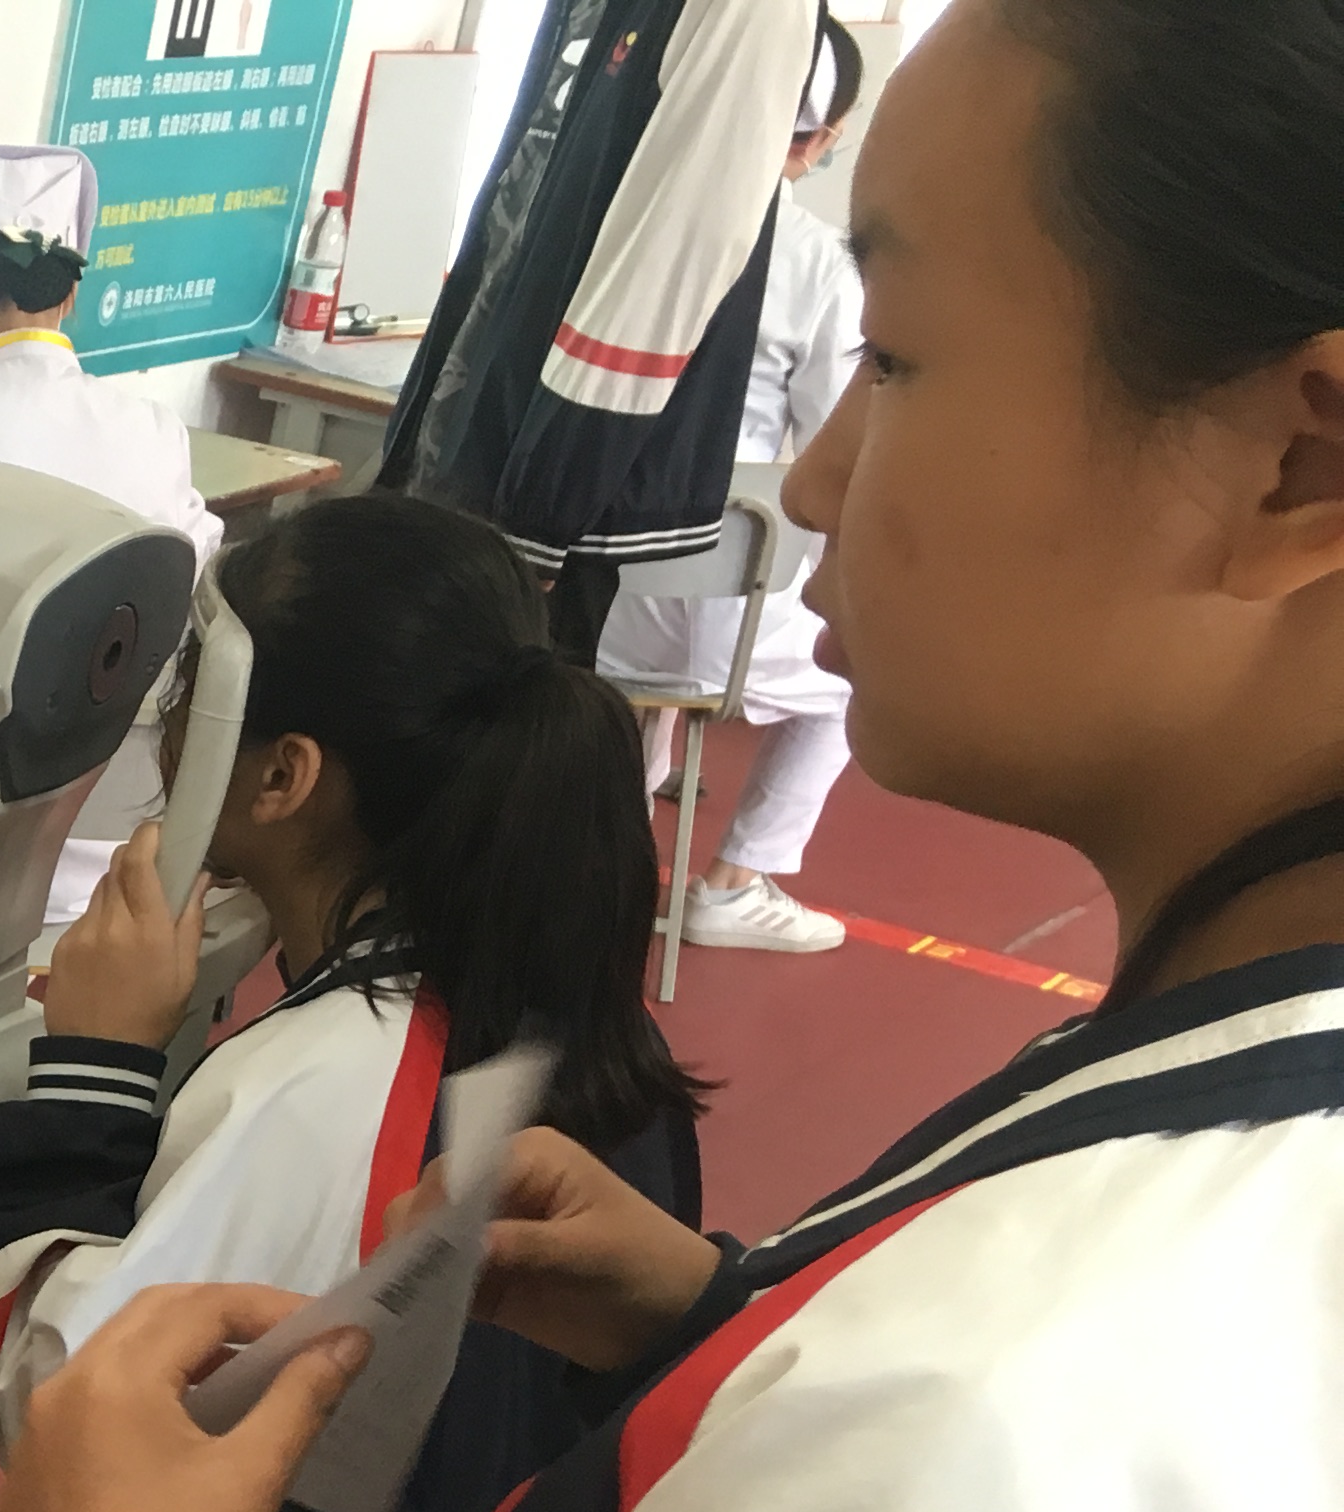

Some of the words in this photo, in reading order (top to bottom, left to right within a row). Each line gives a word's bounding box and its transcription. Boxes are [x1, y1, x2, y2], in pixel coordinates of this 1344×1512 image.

[122, 277, 216, 309] 洛阳市第六人民医院
